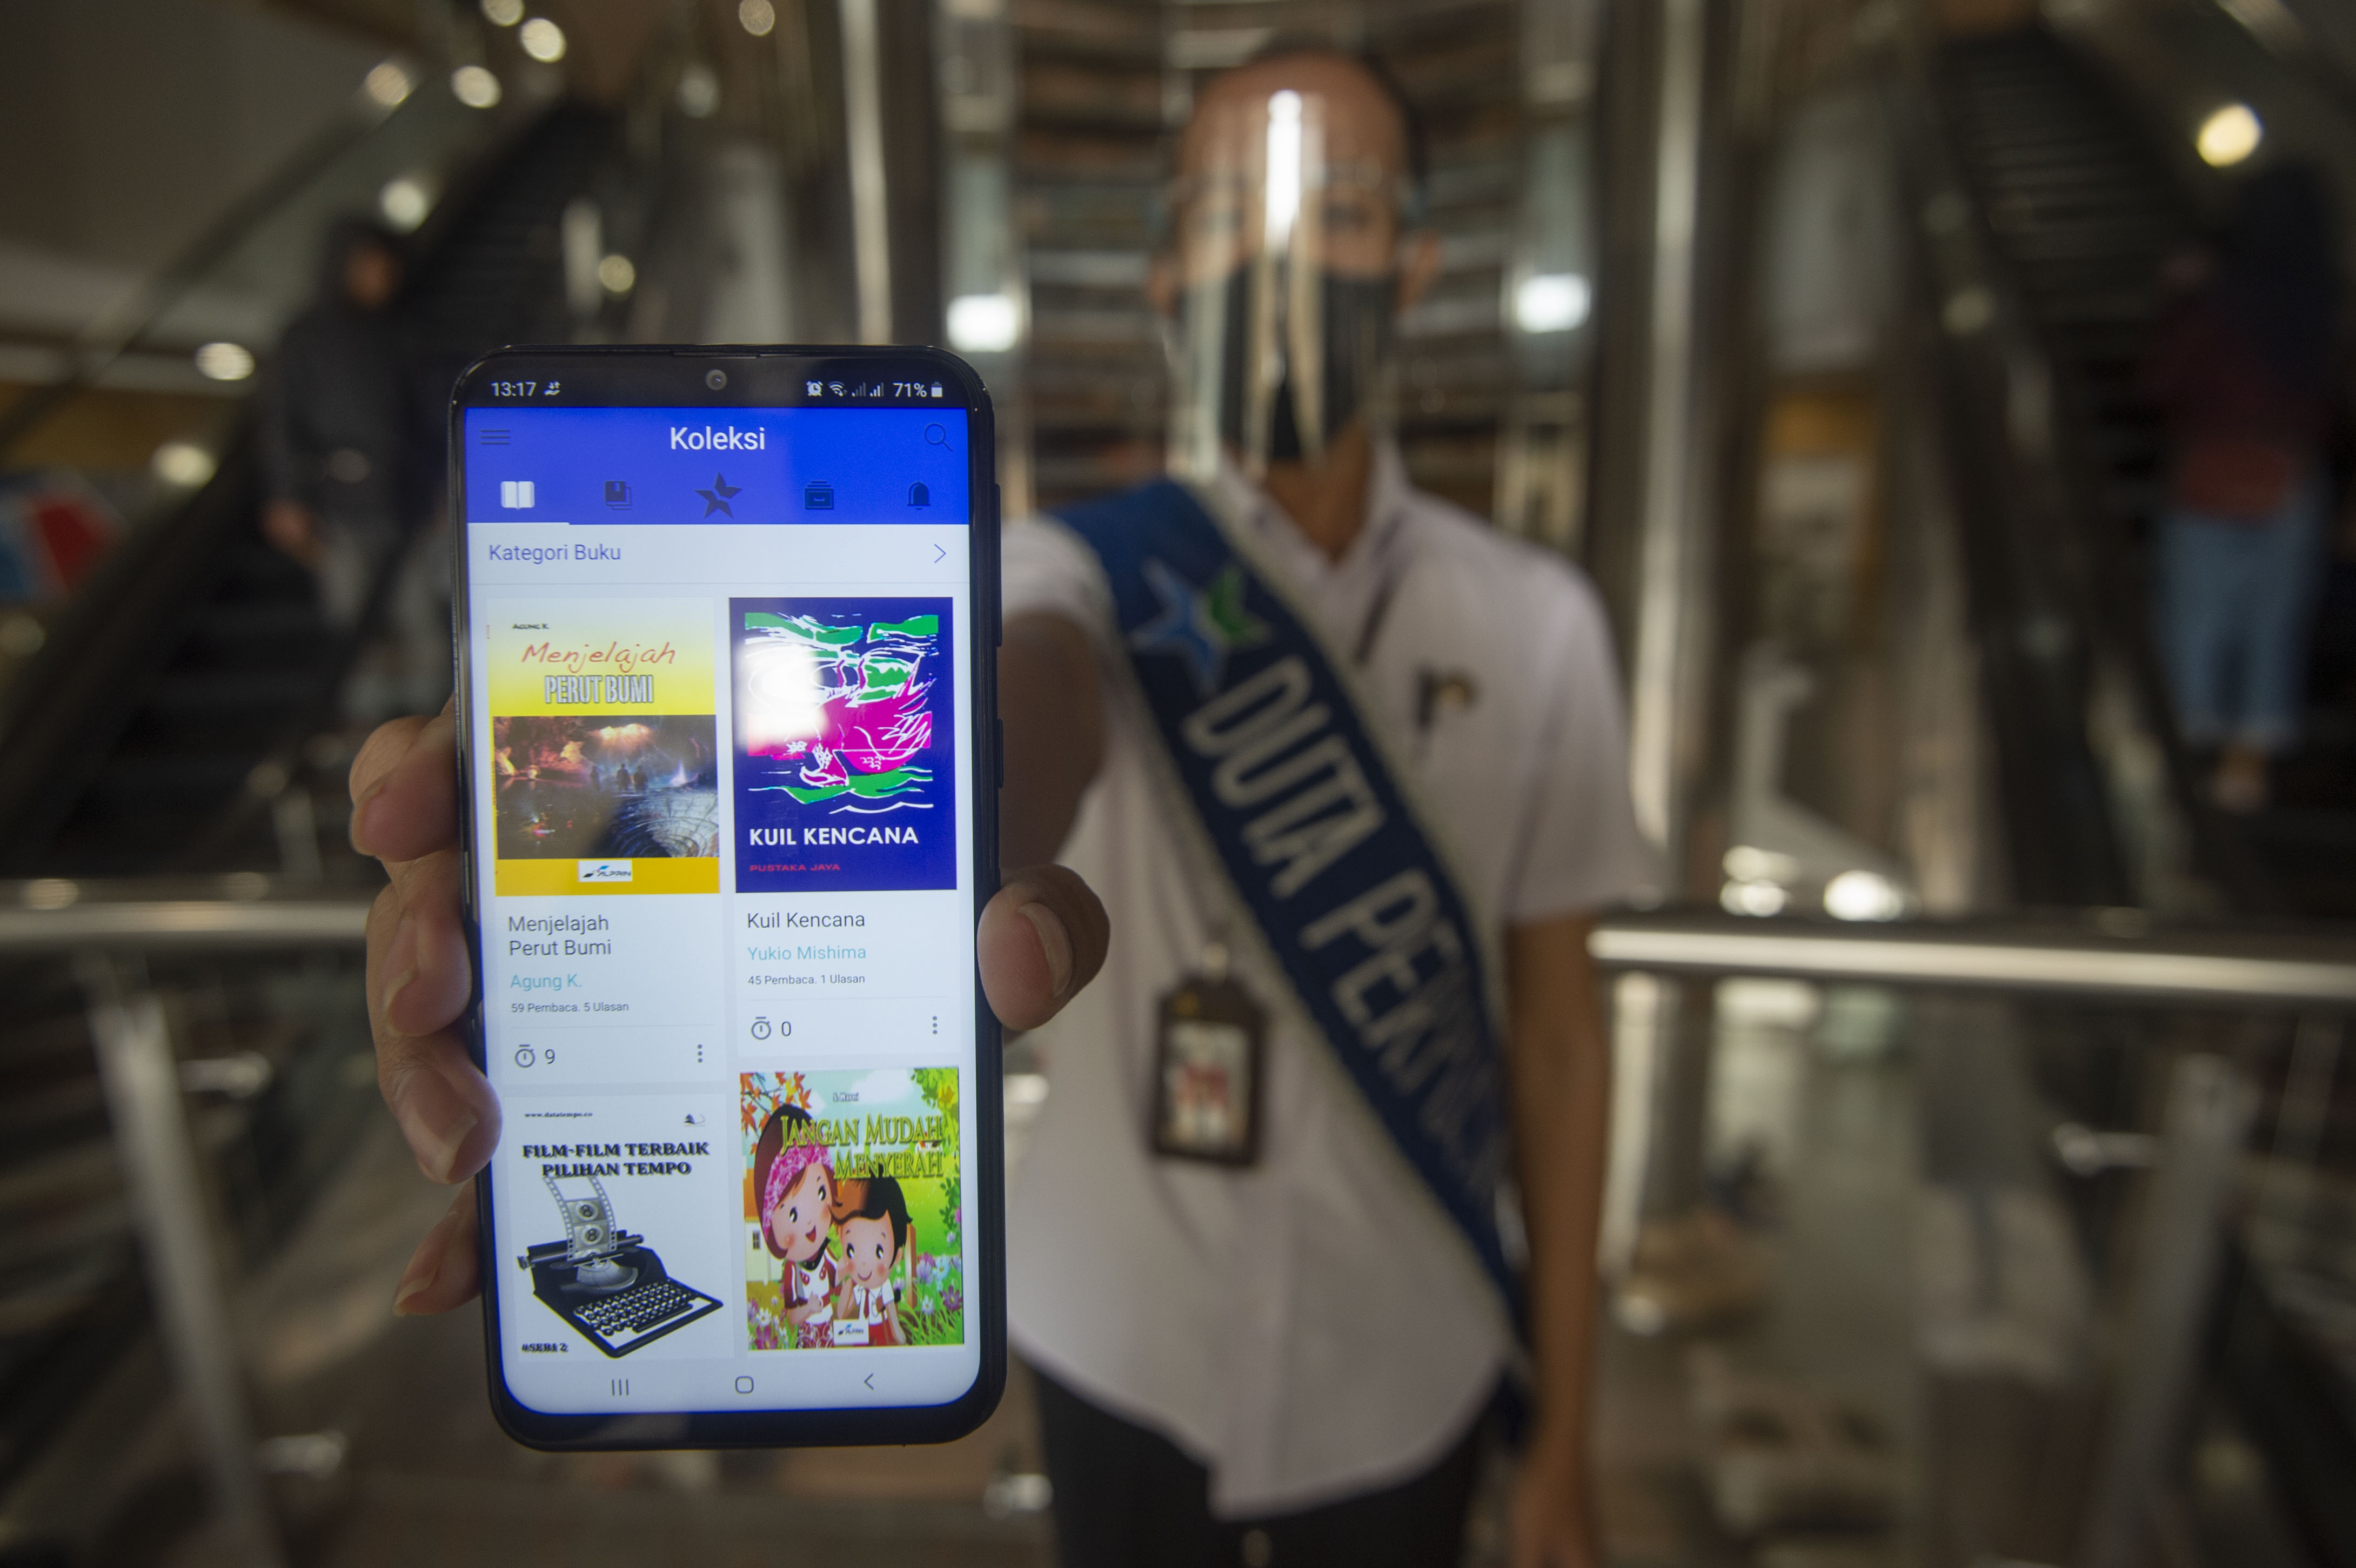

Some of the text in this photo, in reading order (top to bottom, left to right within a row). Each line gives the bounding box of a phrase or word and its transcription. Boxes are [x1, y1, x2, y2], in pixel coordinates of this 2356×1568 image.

[491, 381, 537, 397] 13:17
[893, 381, 927, 397] 71%
[670, 426, 766, 451] Koleksi
[488, 544, 621, 565] Kategori Buku
[521, 641, 675, 673] Menjelajah
[544, 674, 654, 703] PERUT BUMI
[1180, 654, 1388, 900] DUTA
[749, 827, 919, 846] KUIL KENCANA
[508, 915, 608, 935] Menjelajah
[747, 912, 865, 928] Kuil Kencana
[509, 939, 611, 956] Perut Bumi
[747, 945, 866, 960] Yukio Mishima
[510, 974, 583, 991] Agung K.
[748, 974, 865, 985] 45 Pembaca. 1 Ulasan
[511, 1002, 629, 1013] 59 Pembaca. 5 Ulasan
[781, 1021, 792, 1036] 0
[545, 1049, 555, 1064] 9
[781, 1113, 942, 1156] JANGAN MUDAH
[522, 1142, 710, 1158] FILM-FILM TERBAIK
[542, 1161, 692, 1177] PILIHAN TEMPO
[834, 1148, 943, 1183] MENYERAH
